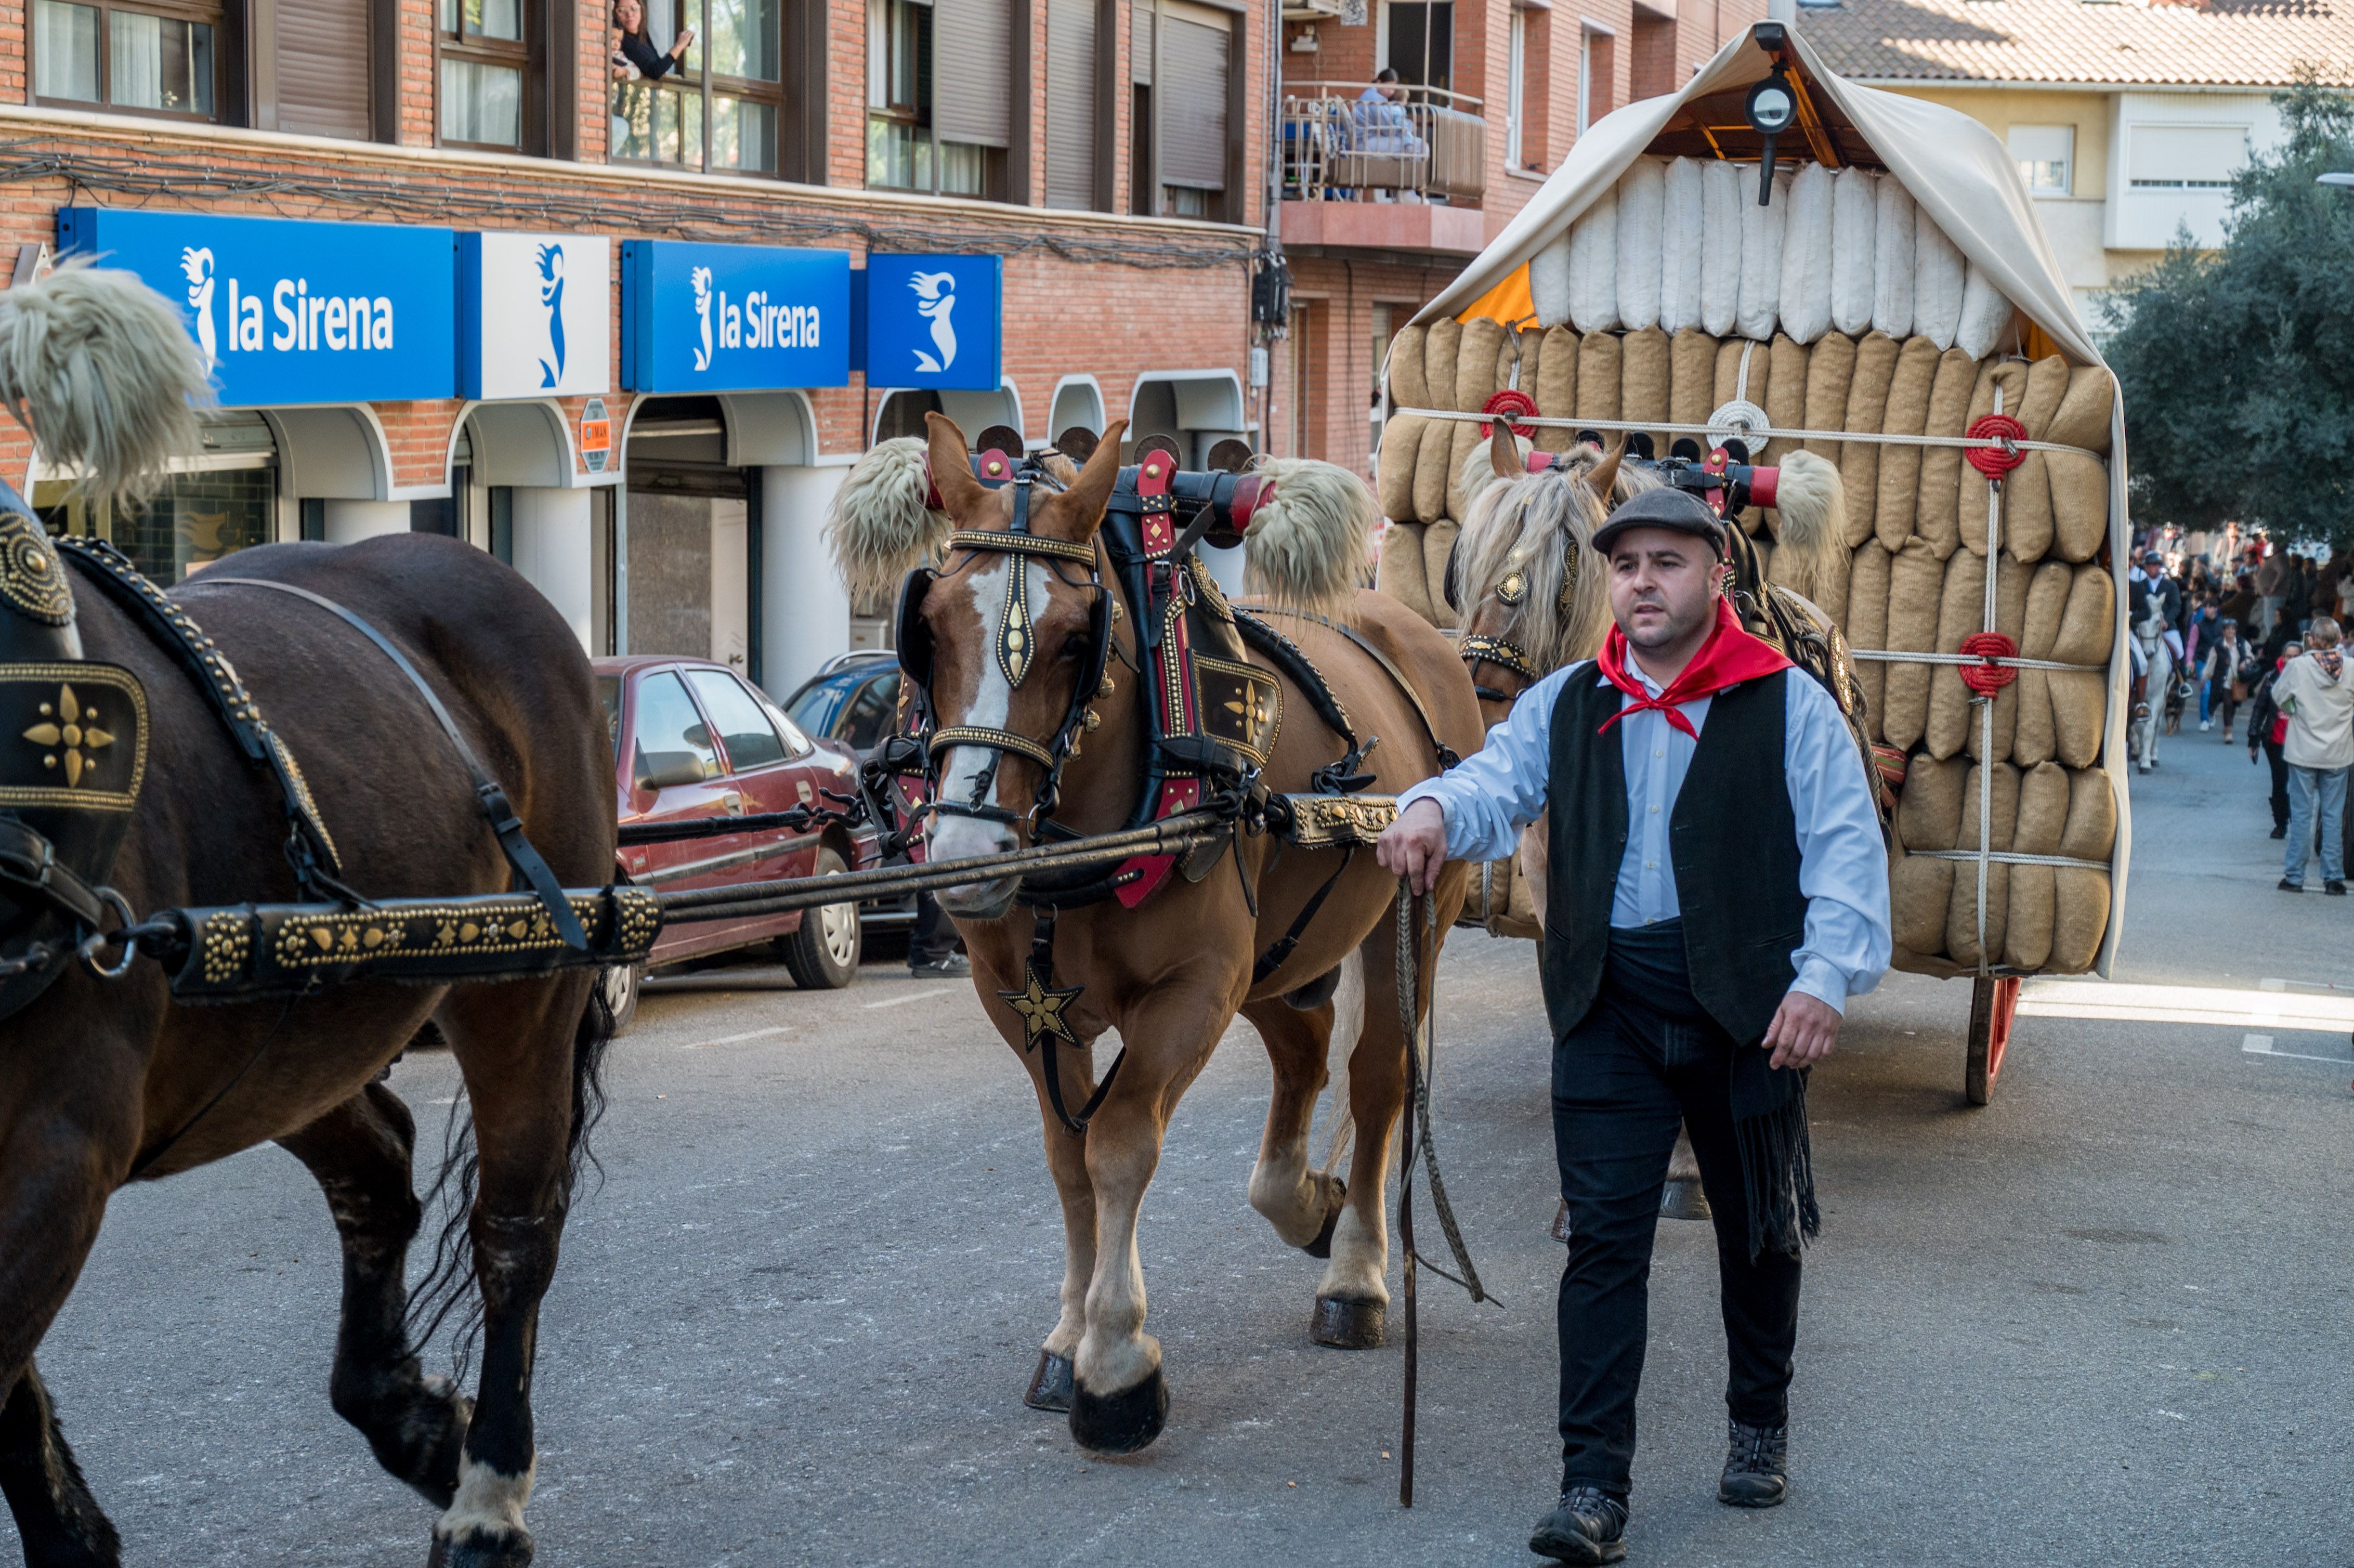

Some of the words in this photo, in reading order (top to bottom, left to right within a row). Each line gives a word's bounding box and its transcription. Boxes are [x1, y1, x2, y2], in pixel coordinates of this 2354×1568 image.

[229, 278, 263, 352] la
[273, 278, 393, 351] Sirena
[720, 291, 741, 349] la
[746, 291, 820, 349] Sirena
